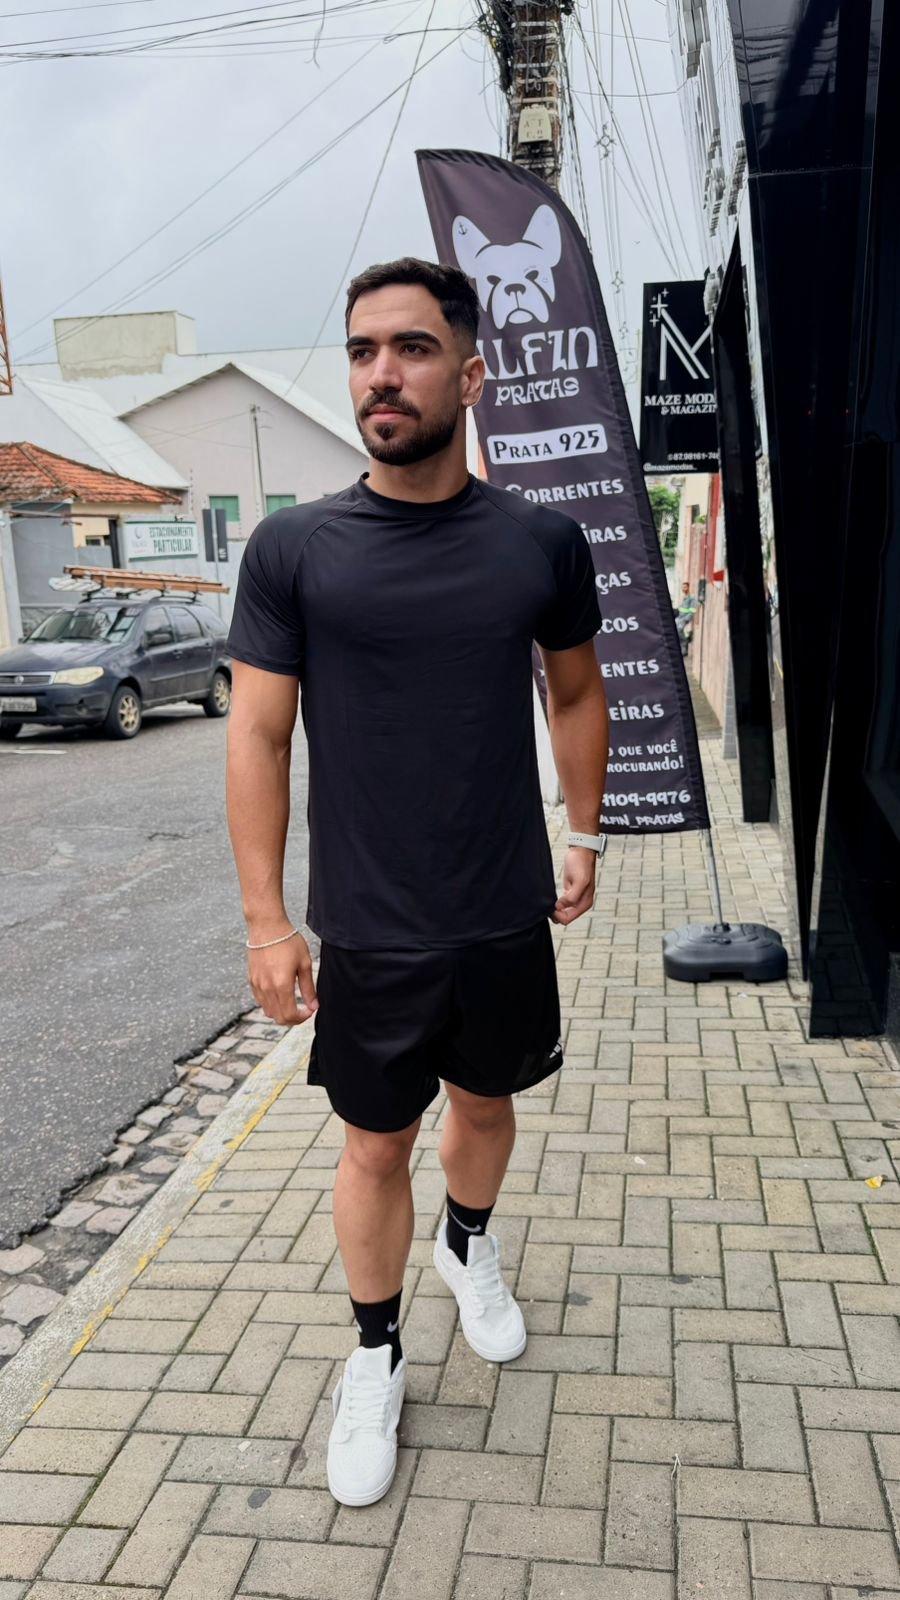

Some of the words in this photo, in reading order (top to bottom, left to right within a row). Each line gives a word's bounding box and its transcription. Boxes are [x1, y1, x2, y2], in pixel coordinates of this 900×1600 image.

[494, 376, 580, 407] PRATAS
[644, 393, 682, 407] MAZE
[660, 406, 669, 415] &
[559, 429, 600, 452] 925
[596, 616, 640, 634] COS
[600, 659, 660, 678] ENTES
[618, 745, 643, 758] QUE
[646, 739, 679, 755] VOCÊ
